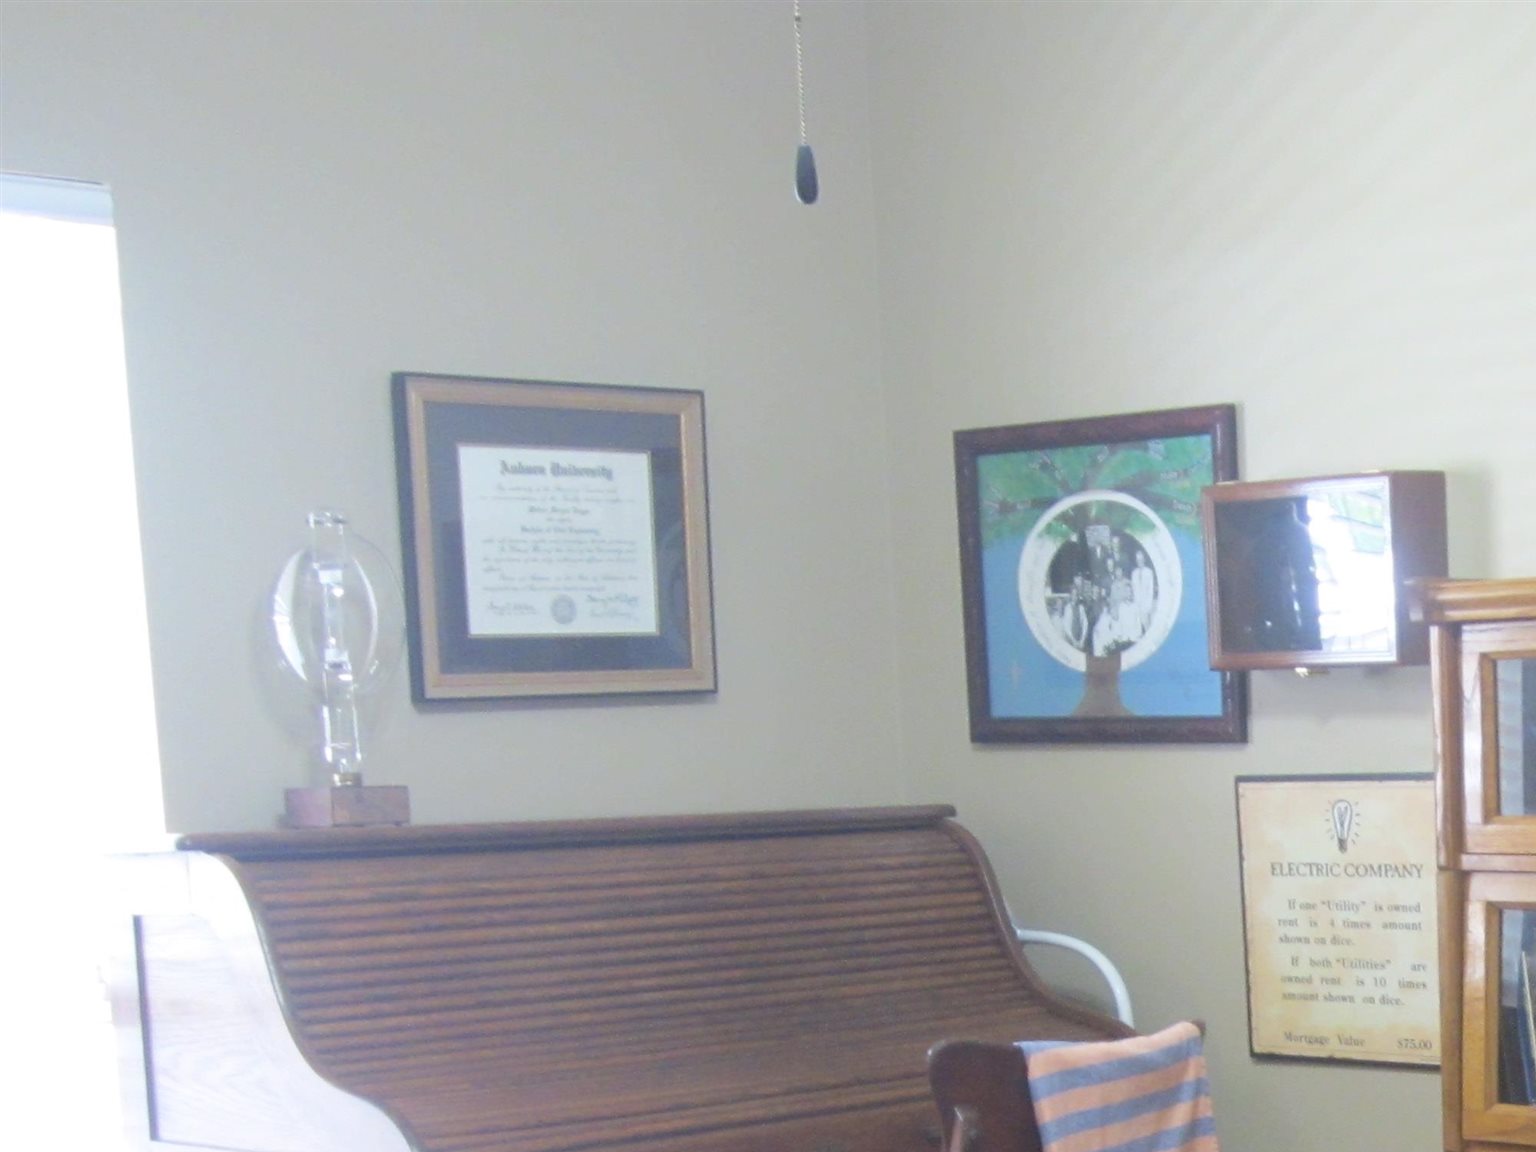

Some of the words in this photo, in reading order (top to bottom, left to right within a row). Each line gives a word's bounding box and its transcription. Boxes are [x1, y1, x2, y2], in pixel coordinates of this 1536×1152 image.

[1270, 863, 1341, 878] ELECTRIC
[1344, 863, 1424, 879] COMPANY
[1387, 901, 1422, 913] owned
[1277, 917, 1299, 927] rent
[1341, 918, 1372, 930] times
[1381, 920, 1422, 931] amount
